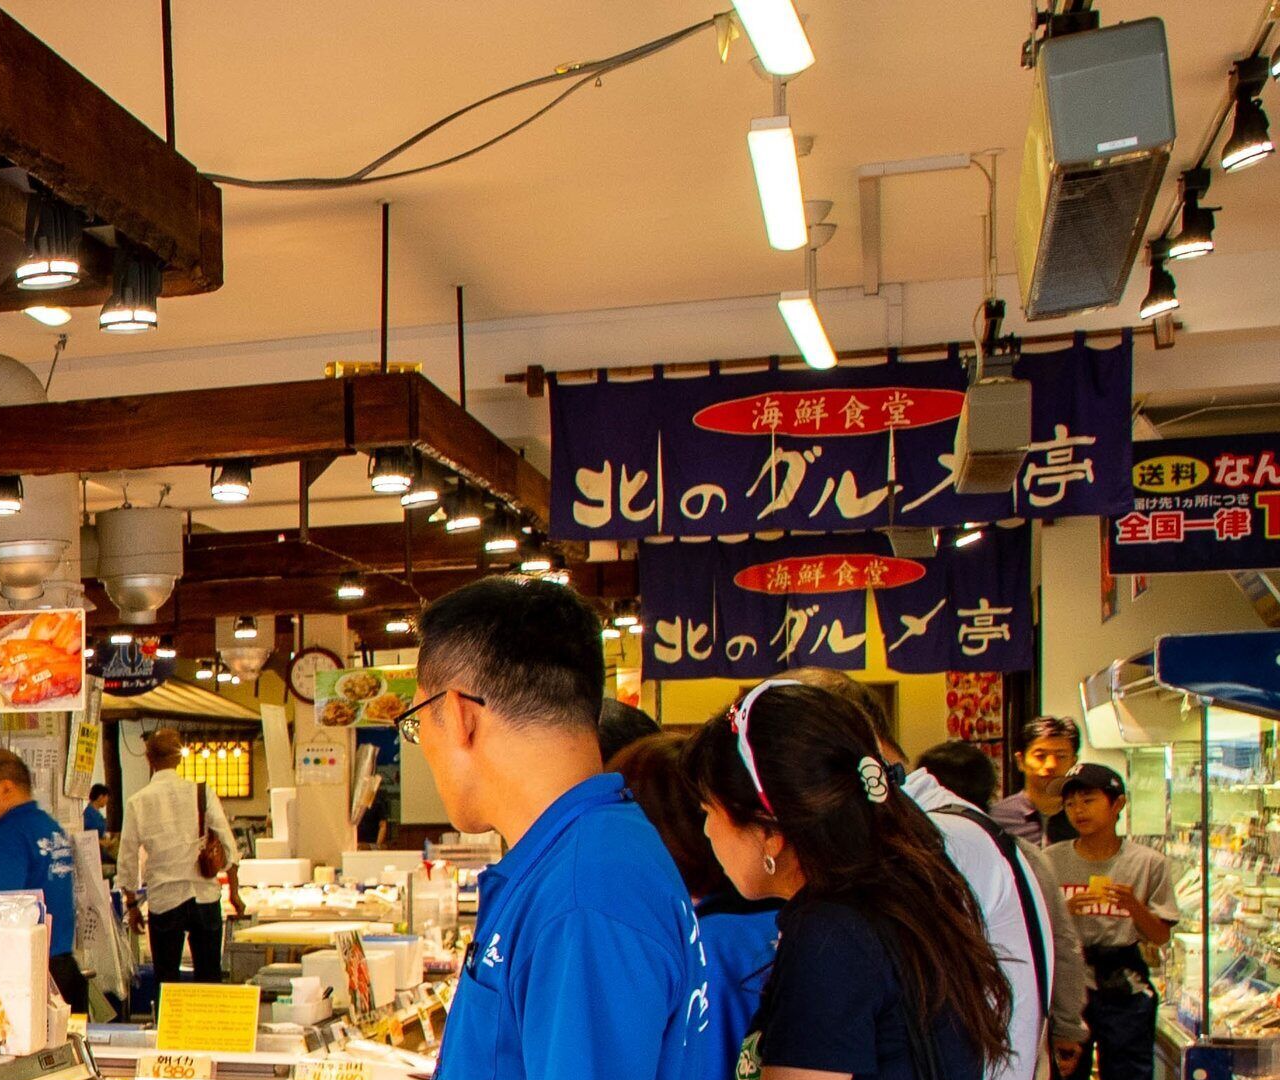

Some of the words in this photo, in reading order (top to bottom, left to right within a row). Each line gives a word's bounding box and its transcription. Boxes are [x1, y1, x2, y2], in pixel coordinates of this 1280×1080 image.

[751, 393, 914, 430] 海鮮食堂
[1139, 462, 1197, 487] 送料
[1115, 507, 1252, 545] 全国一律
[766, 559, 890, 590] 海鮮食堂
[652, 599, 1014, 664] 北のグルメ亭
